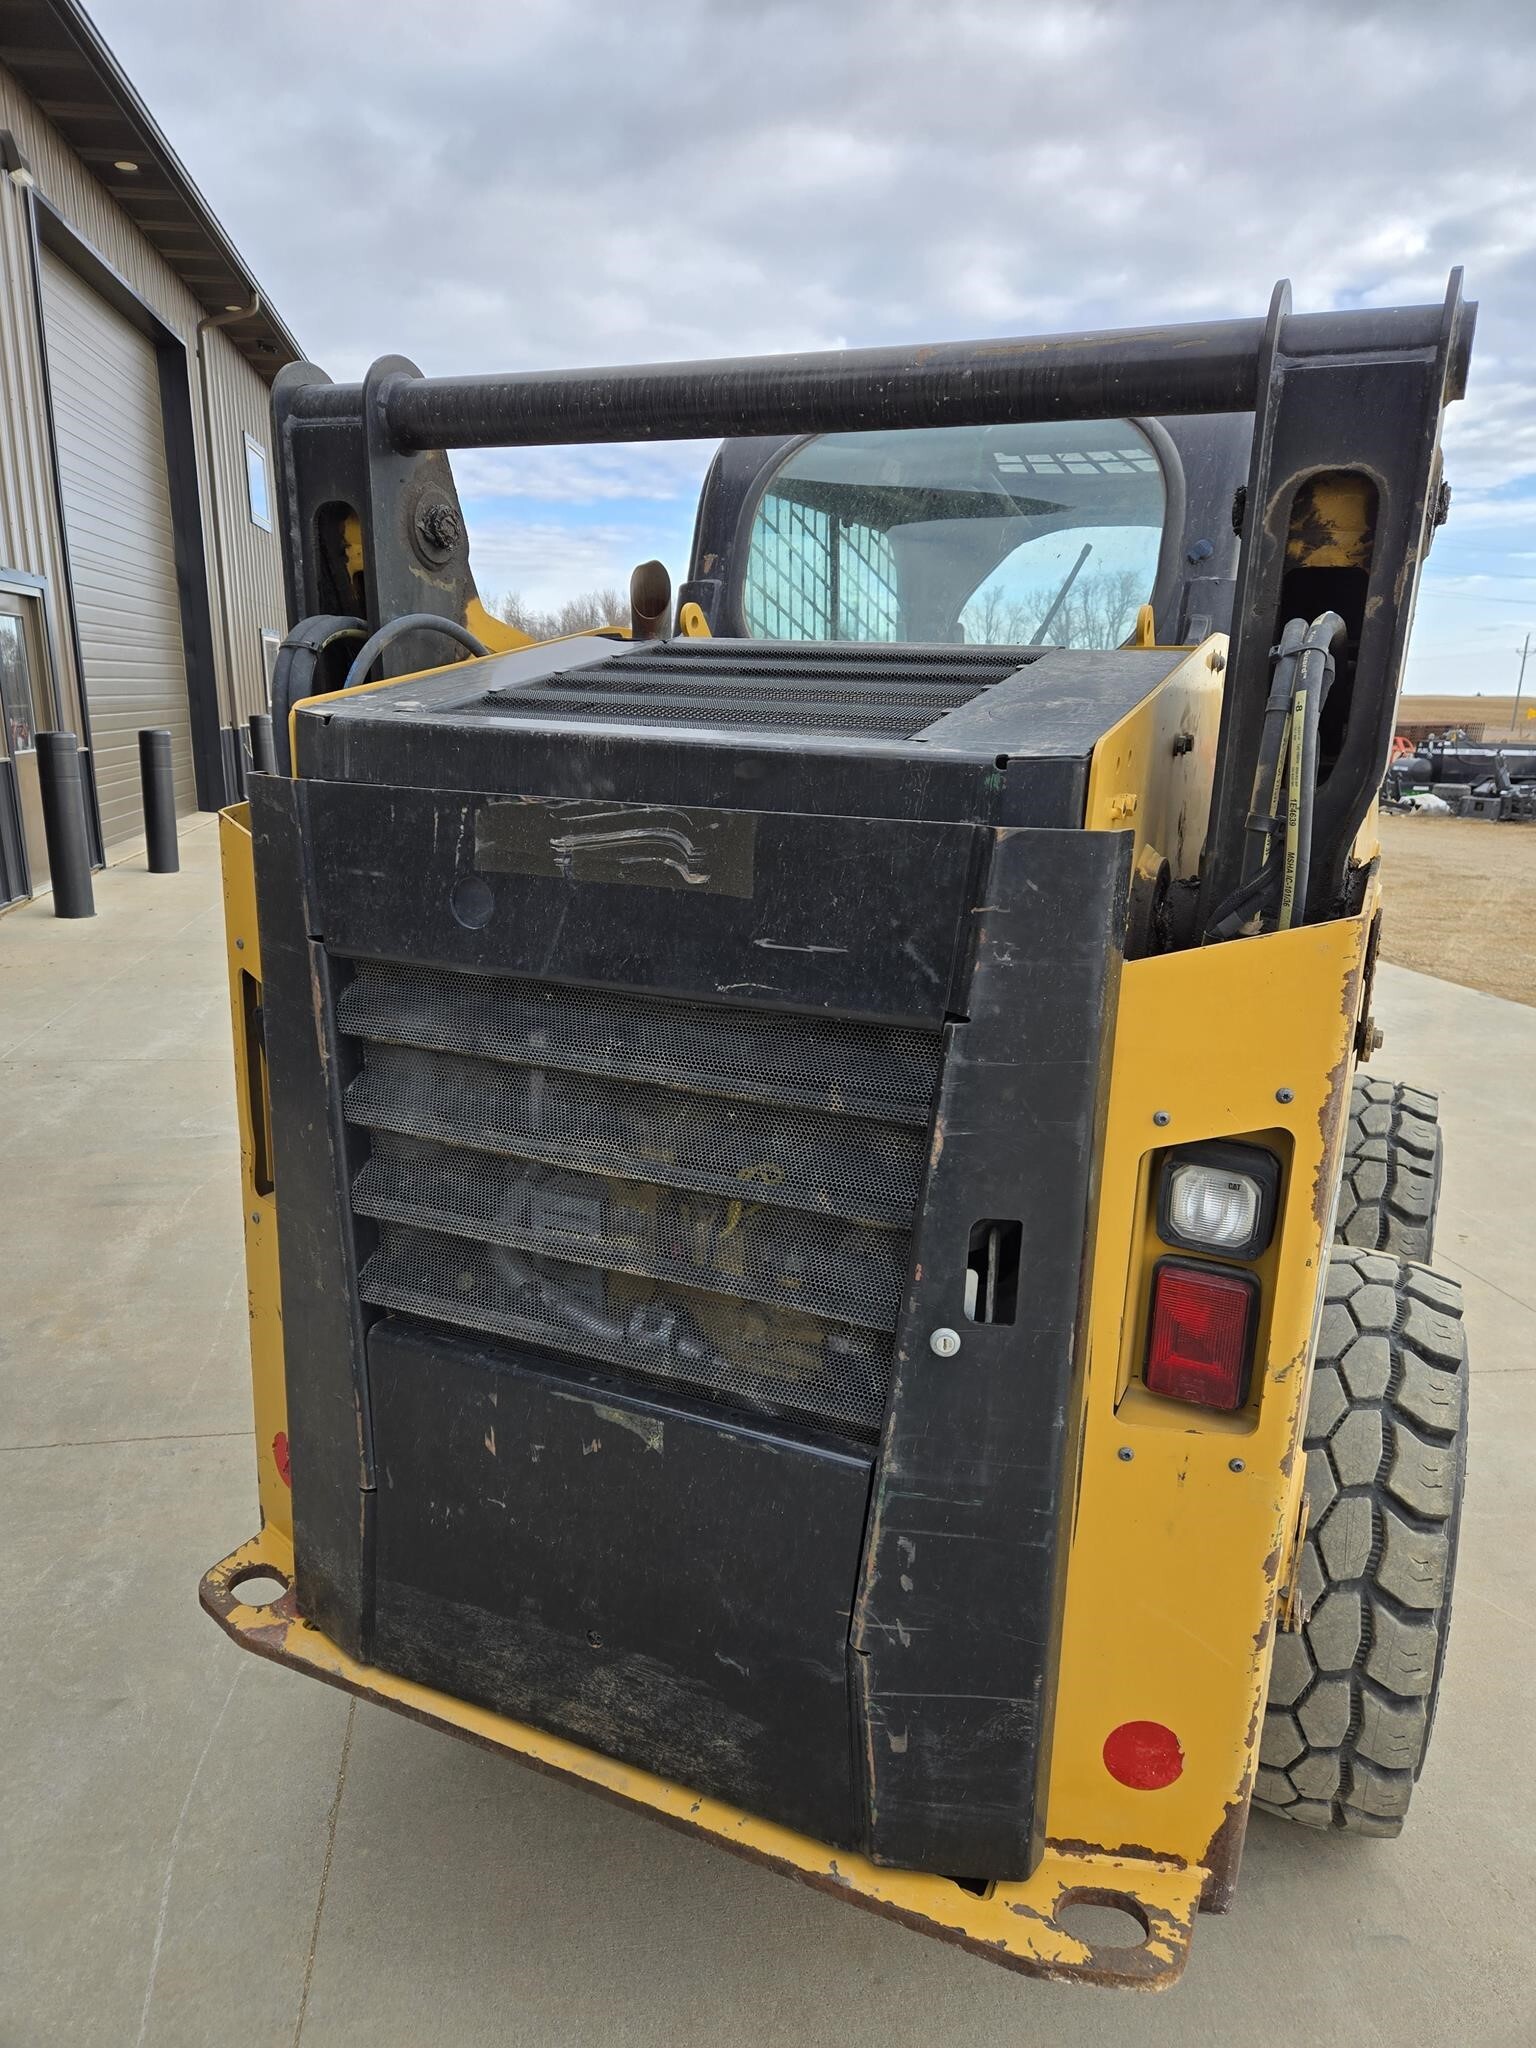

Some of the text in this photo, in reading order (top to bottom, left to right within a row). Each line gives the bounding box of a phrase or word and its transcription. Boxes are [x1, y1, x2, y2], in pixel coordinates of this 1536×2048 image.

[1289, 798, 1298, 827] 1E4639
[1282, 851, 1296, 907] MSHA IC-101/36
[1228, 1182, 1241, 1191] CAT
